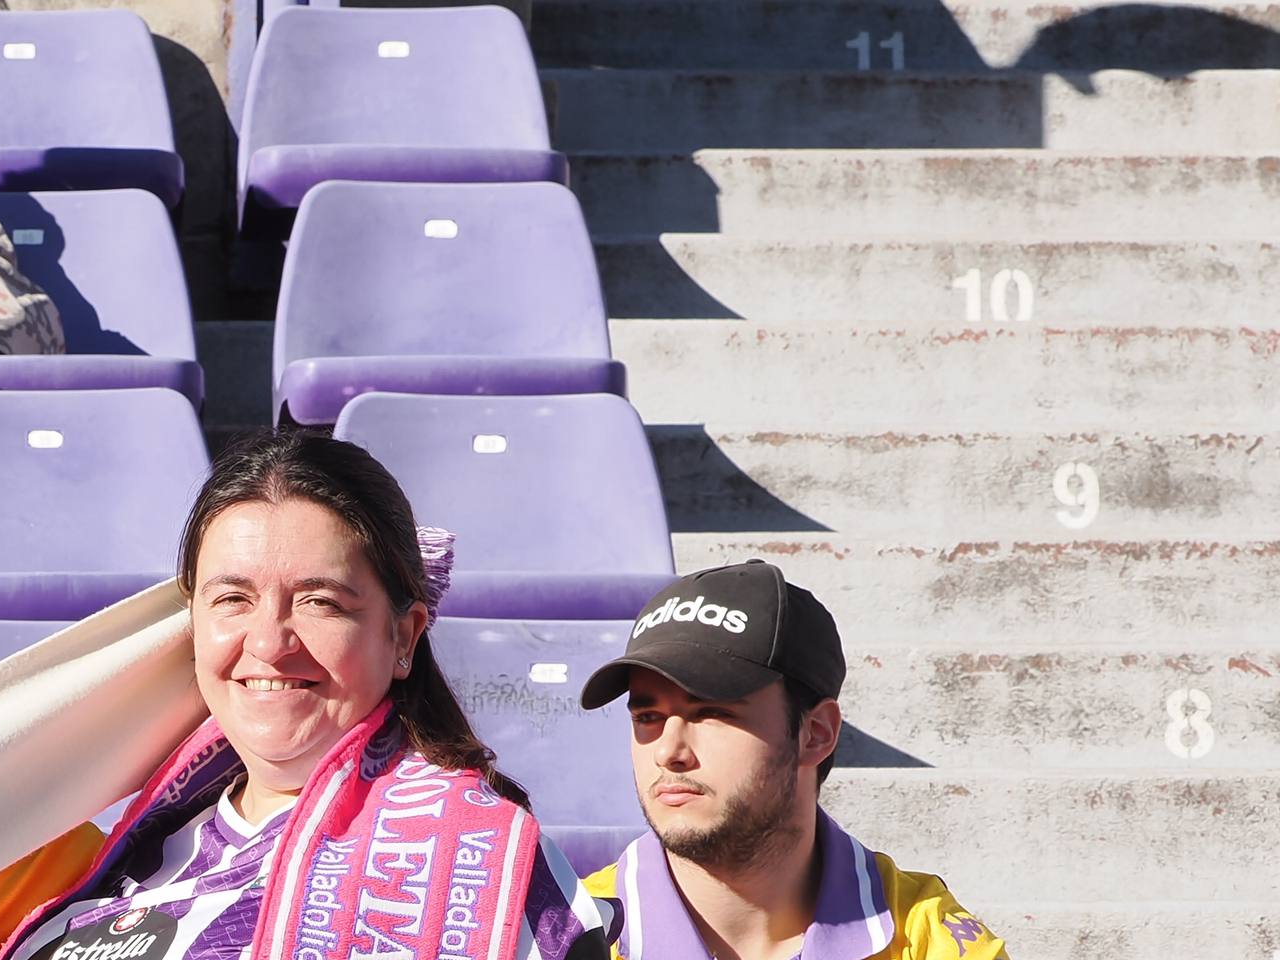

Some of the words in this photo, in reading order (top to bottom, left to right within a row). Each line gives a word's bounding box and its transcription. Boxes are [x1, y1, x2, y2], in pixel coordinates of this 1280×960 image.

[846, 31, 905, 71] 11
[952, 268, 1034, 322] 10
[1052, 462, 1100, 529] 9
[632, 595, 749, 640] adidas
[1164, 688, 1215, 760] 8
